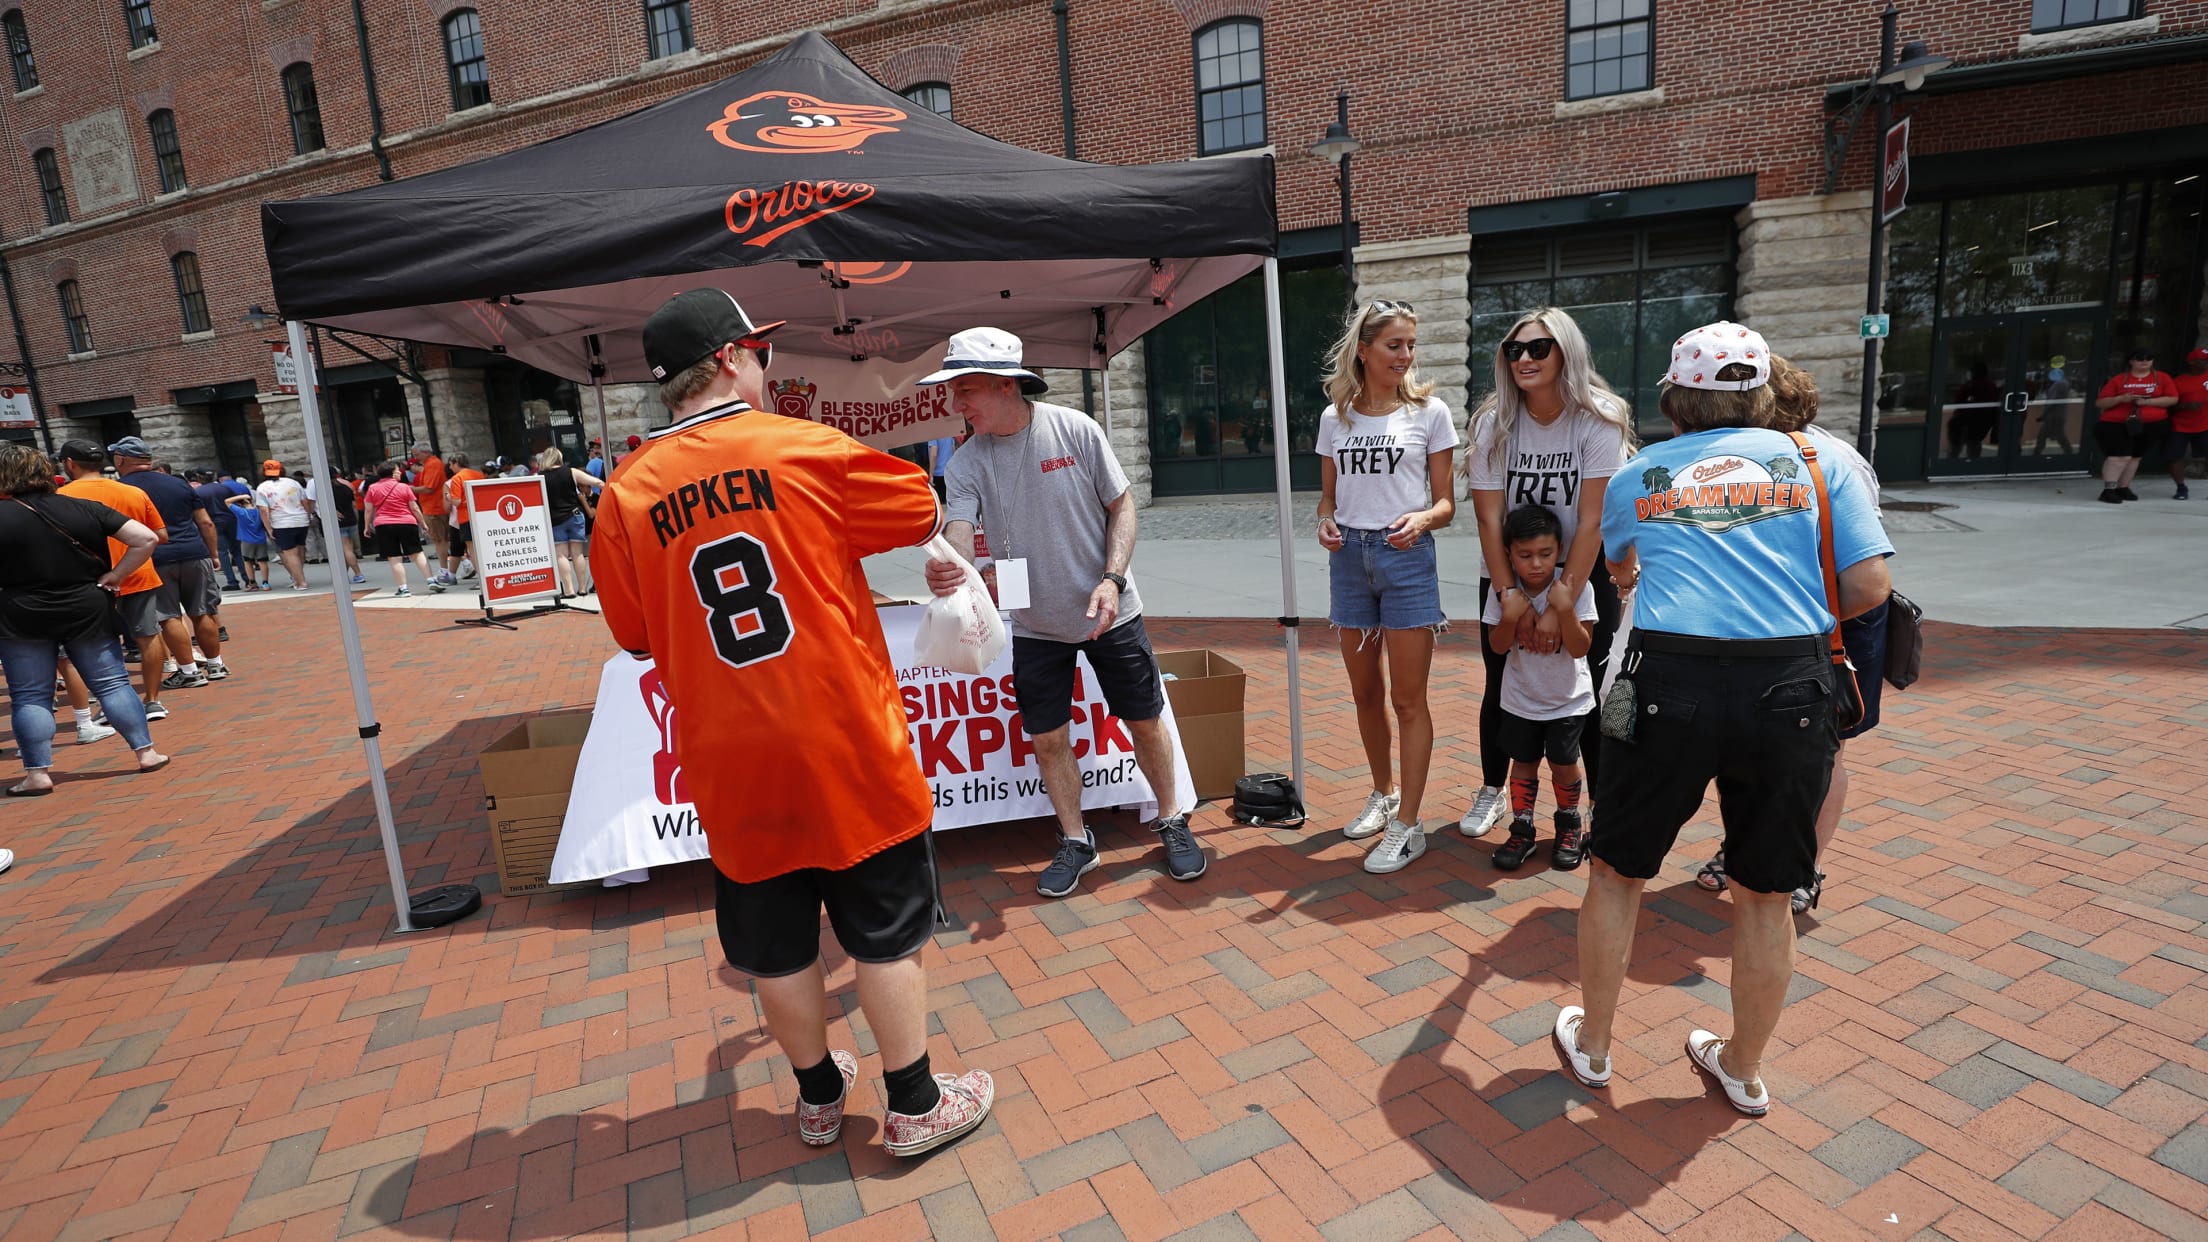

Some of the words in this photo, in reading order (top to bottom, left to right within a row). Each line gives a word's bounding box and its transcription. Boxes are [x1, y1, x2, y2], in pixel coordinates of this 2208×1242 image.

[725, 180, 876, 240] Orioles
[821, 397, 910, 417] BLESSINGS
[916, 388, 930, 404] IN
[935, 384, 947, 398] A
[1345, 436, 1364, 447] I'M
[1365, 435, 1397, 447] WITH
[1337, 447, 1405, 475] TREY
[1536, 452, 1572, 470] WITH
[1692, 458, 1745, 483] Orioles
[1507, 470, 1579, 506] TREY
[1634, 484, 1726, 521] DREAM
[1728, 482, 1813, 509] WEEK
[649, 468, 777, 549] RIPKEN
[1692, 508, 1731, 516] SARASOTA,
[487, 527, 518, 537] ORIOLE
[518, 524, 541, 534] PARK
[494, 536, 536, 547] FEATURES
[486, 555, 549, 570] TRANSACTIONS
[495, 546, 538, 558] CASHLESS
[688, 531, 796, 669] 8
[908, 703, 1135, 778] KPAK
[652, 809, 703, 840] Wh
[962, 776, 1009, 804] this
